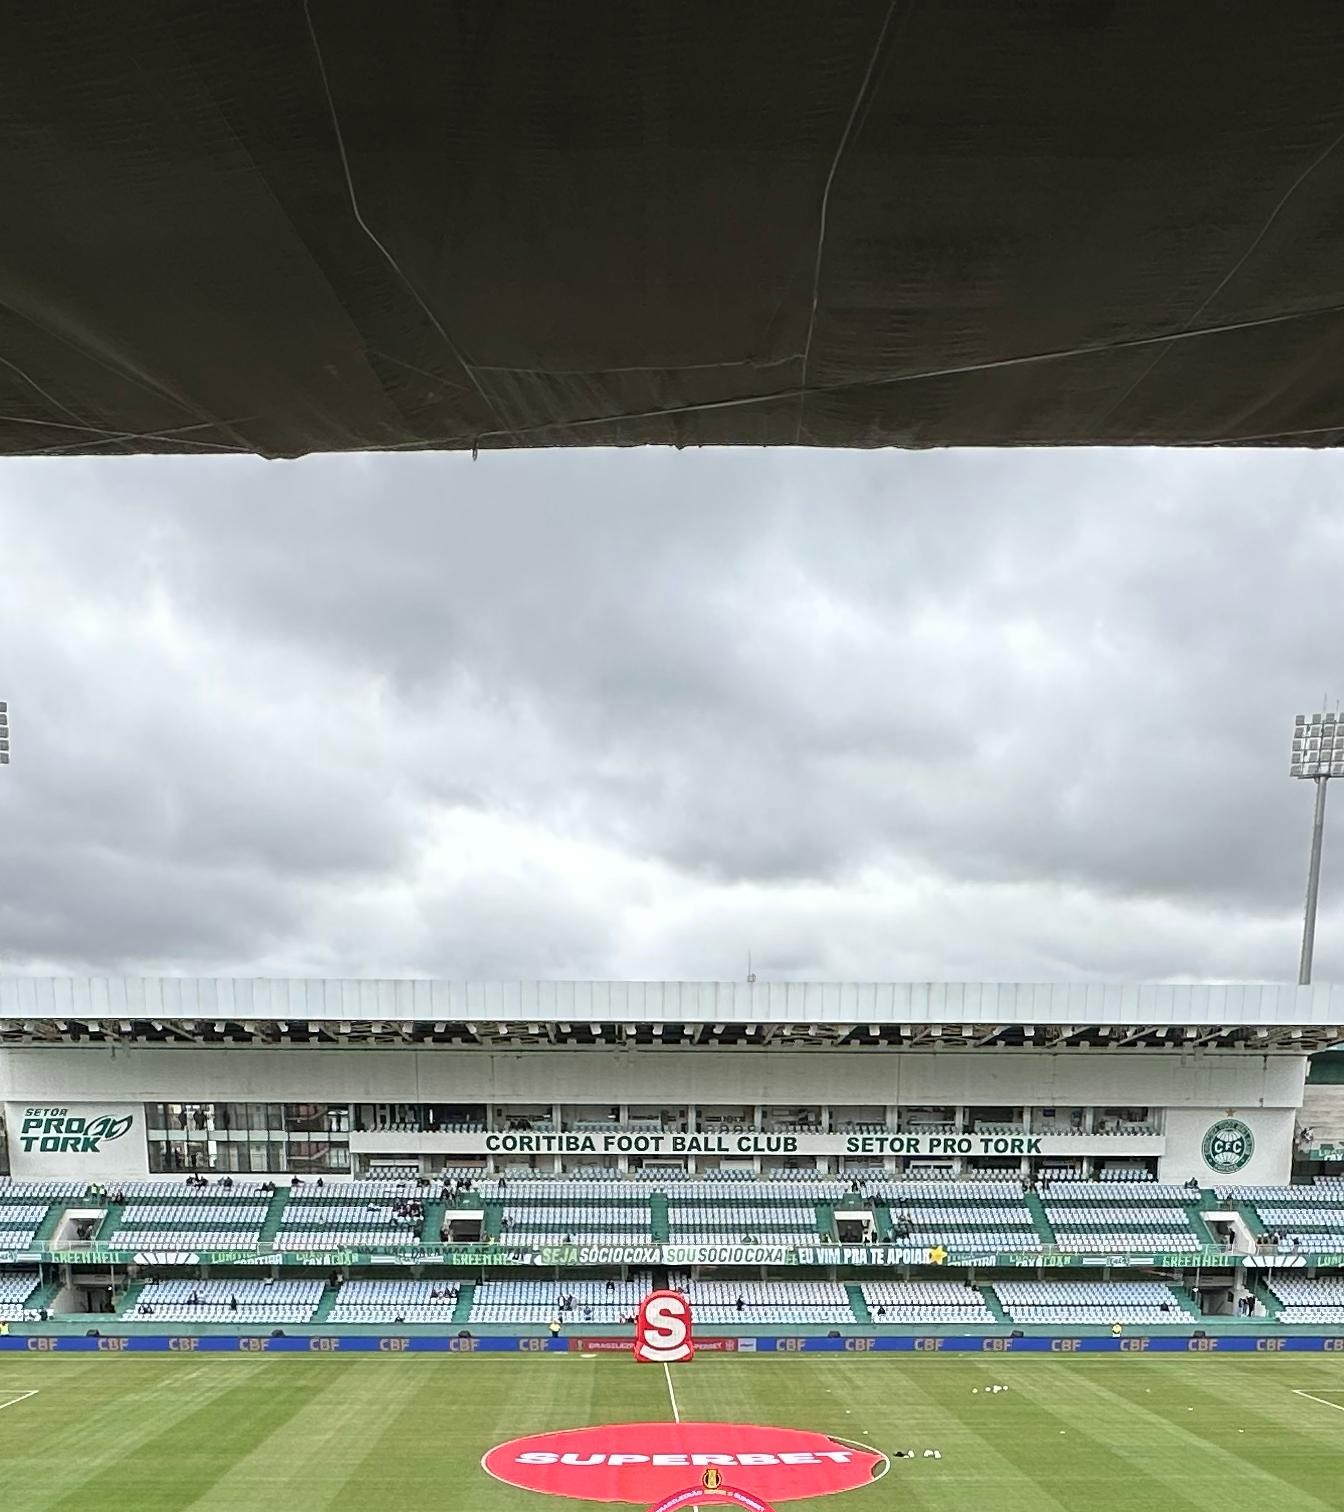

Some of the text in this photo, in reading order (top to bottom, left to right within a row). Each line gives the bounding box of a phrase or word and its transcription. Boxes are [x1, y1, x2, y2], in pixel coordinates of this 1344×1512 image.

[25, 1107, 69, 1117] SETOR
[21, 1117, 88, 1135] PRO
[20, 1136, 102, 1153] TORK
[486, 1135, 799, 1152] CORITIBA FOOT BALL CLUB
[847, 1137, 1042, 1154] SETOR PRO TORK
[1214, 1140, 1242, 1153] CFC
[541, 1248, 578, 1264] SEJA
[666, 1247, 696, 1263] SOU
[799, 1248, 814, 1264] EU
[817, 1248, 840, 1264] VIM
[844, 1248, 867, 1264] PRA
[870, 1248, 884, 1264] TE
[643, 1297, 687, 1348] S
[27, 1337, 58, 1351] CBF
[97, 1337, 128, 1351] CBF
[168, 1337, 199, 1351] CBF
[239, 1337, 269, 1351] CBF
[309, 1337, 340, 1351] CBF
[379, 1337, 410, 1351] CBF
[449, 1337, 480, 1351] CBF
[519, 1337, 549, 1351] CBF
[776, 1338, 806, 1352] CBF
[845, 1338, 875, 1352] CBF
[914, 1338, 944, 1352] CBF
[983, 1338, 1013, 1352] CBF
[1051, 1338, 1081, 1352] CBF
[1120, 1338, 1150, 1352] CBF
[1188, 1338, 1218, 1352] CBF
[1256, 1338, 1286, 1352] CBF
[514, 1450, 854, 1467] SUPERBET
